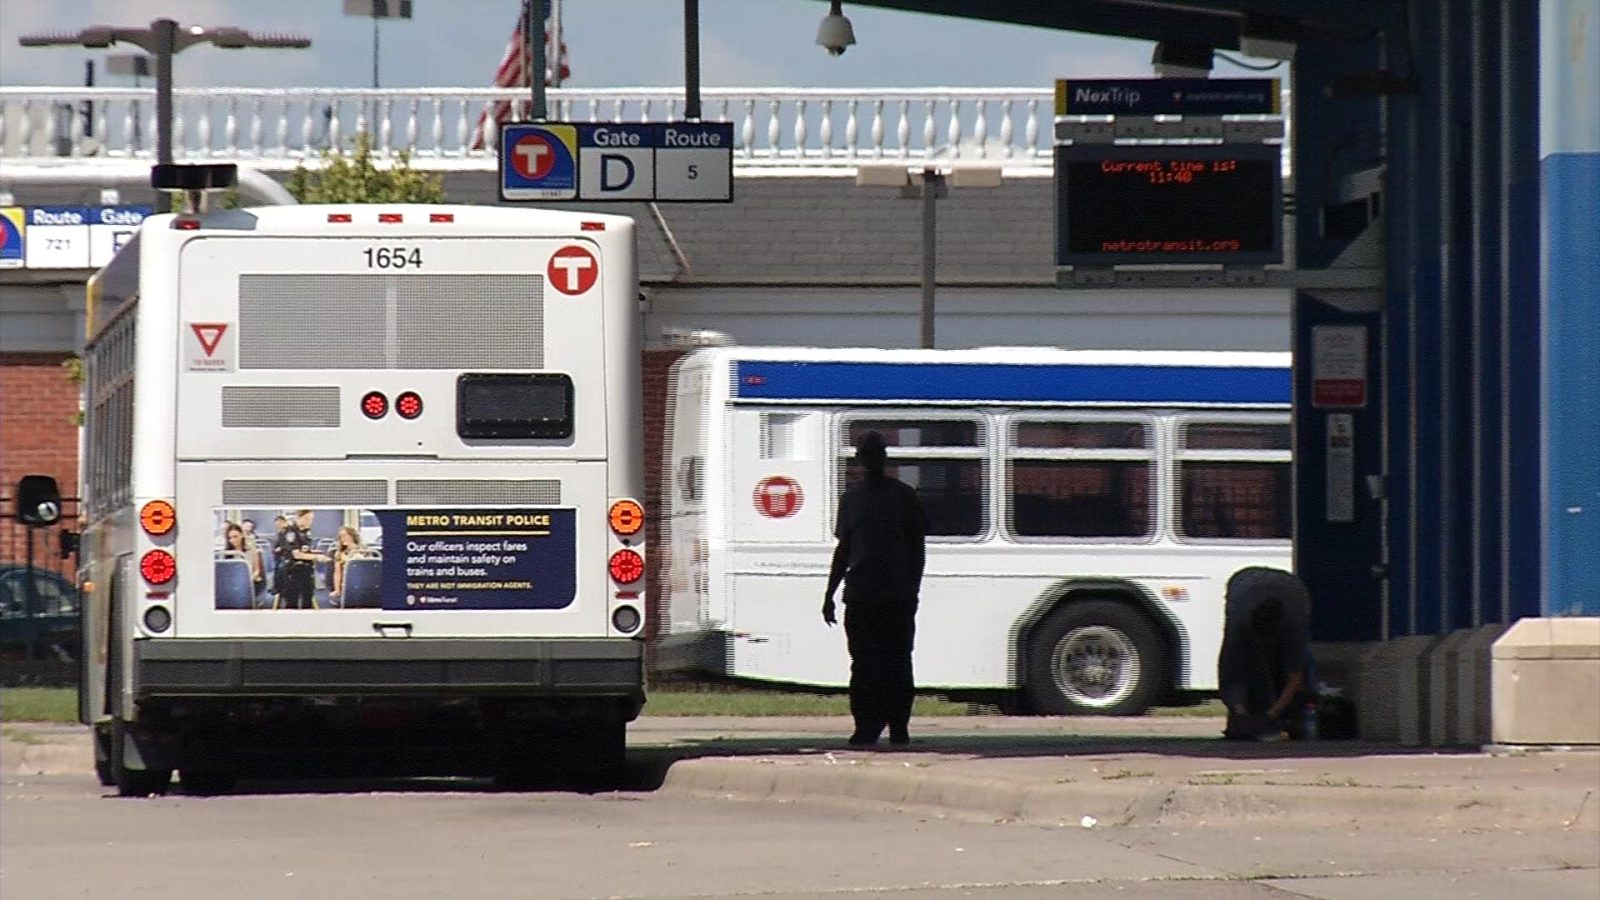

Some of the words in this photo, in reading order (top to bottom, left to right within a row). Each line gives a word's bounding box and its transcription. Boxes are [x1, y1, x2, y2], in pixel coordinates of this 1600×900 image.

[1075, 88, 1141, 106] NexTrip
[593, 128, 641, 146] Gate
[665, 128, 721, 146] Route
[600, 154, 635, 192] D
[687, 164, 698, 180] 5
[1101, 160, 1162, 172] Current
[1171, 160, 1204, 172] time
[1212, 160, 1237, 171] is:
[33, 209, 82, 225] Route
[101, 208, 143, 225] Gate
[45, 238, 71, 250] 721
[363, 248, 423, 268] 1654
[406, 515, 450, 526] METRO
[453, 515, 504, 526] TRANSIT
[507, 514, 550, 526] POLICE
[406, 542, 427, 552] Our
[428, 541, 464, 552] officers
[466, 541, 502, 554] inspect
[503, 541, 528, 552] fares
[406, 554, 426, 564] and
[428, 554, 470, 564] maintain
[471, 553, 501, 566] safety
[502, 555, 516, 564] on
[406, 566, 434, 577] trains
[436, 566, 455, 576] and
[457, 566, 488, 577] buses.
[406, 582, 425, 590] THEY
[425, 582, 440, 590] ARE
[441, 582, 456, 590] NOT
[457, 581, 502, 590] IMMIGRATION
